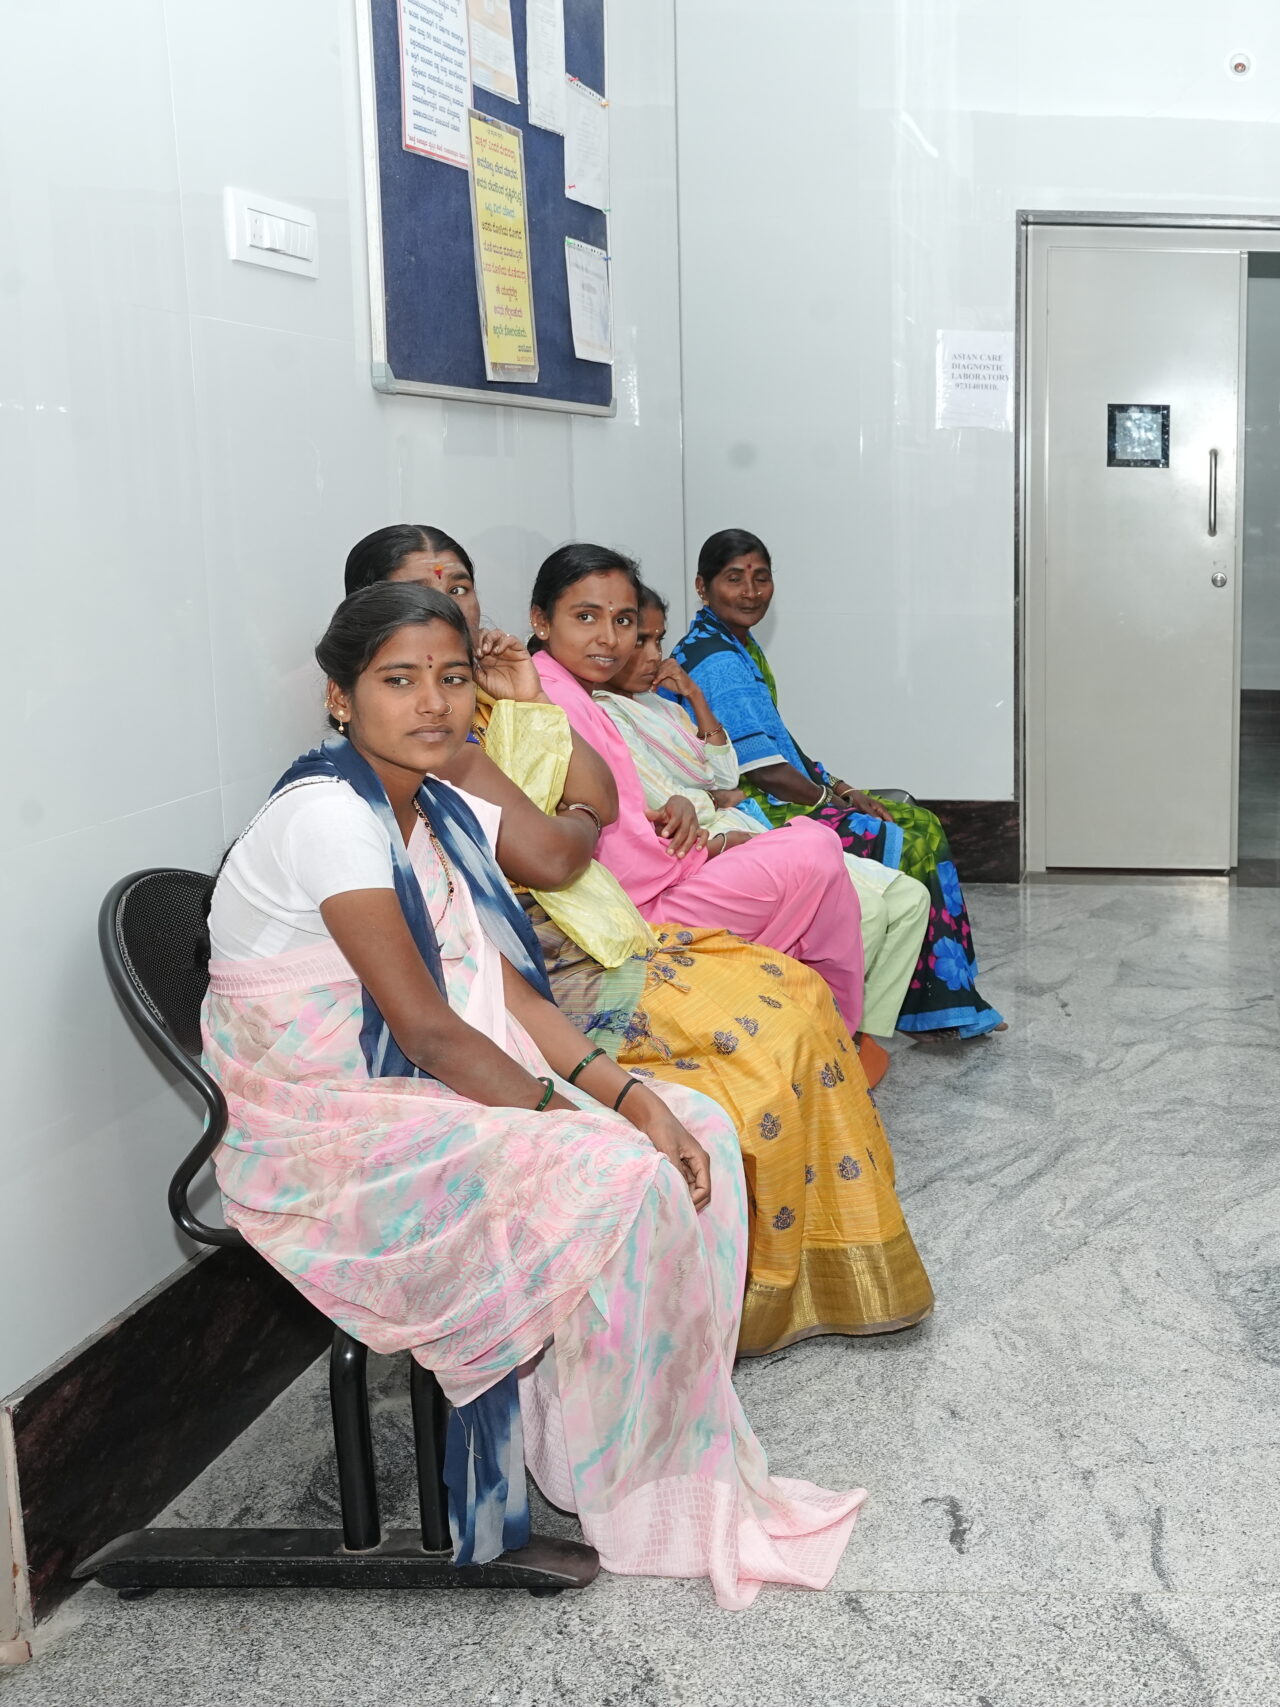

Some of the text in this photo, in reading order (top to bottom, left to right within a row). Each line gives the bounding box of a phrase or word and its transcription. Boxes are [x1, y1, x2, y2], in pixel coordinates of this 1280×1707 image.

[952, 353, 977, 361] ASIAN
[951, 363, 1004, 371] DIAGNOSTIC
[951, 373, 1009, 381] LABORATORY
